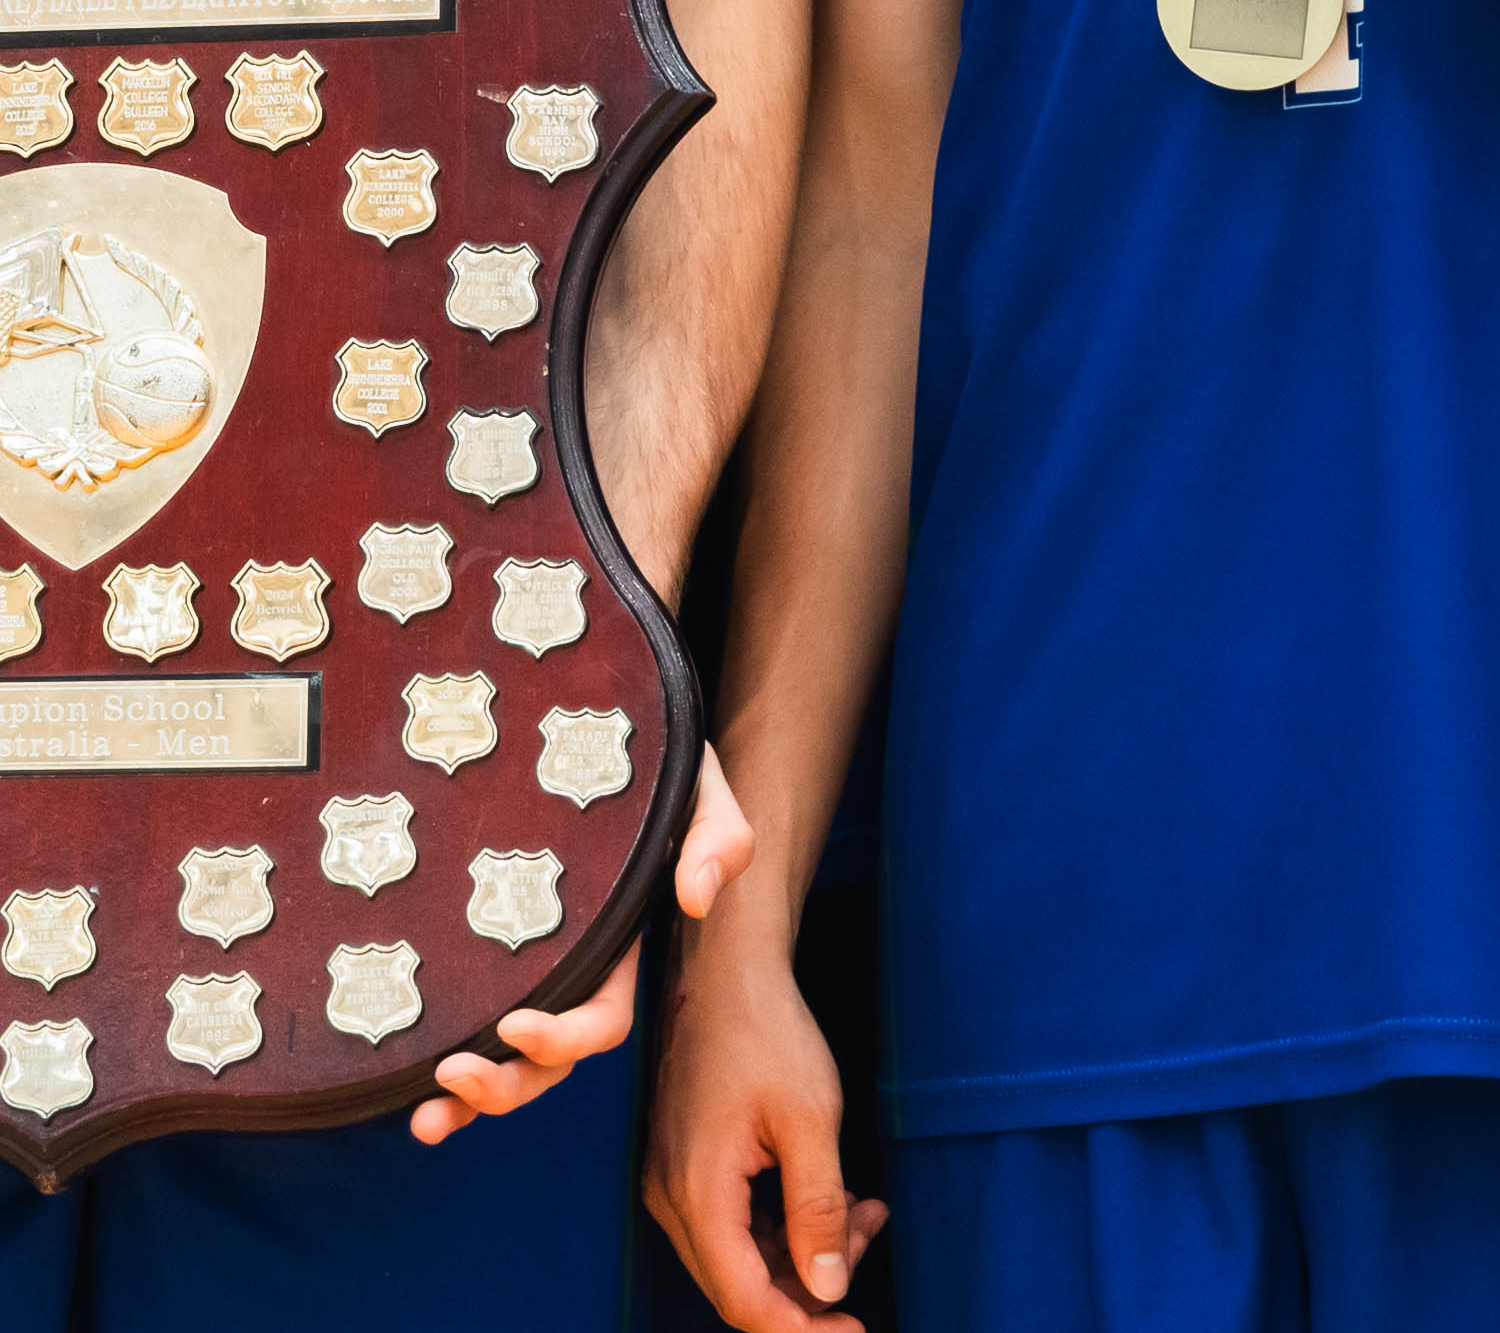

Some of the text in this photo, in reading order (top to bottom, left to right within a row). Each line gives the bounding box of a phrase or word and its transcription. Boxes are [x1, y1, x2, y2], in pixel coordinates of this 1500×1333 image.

[122, 76, 170, 89] MARCELLIN
[257, 83, 291, 93] SENIOR
[125, 92, 168, 104] COLLEGE
[4, 110, 47, 122] COLLEGE
[124, 106, 168, 118] BULLEEN
[254, 107, 294, 118] COLLEGE
[529, 136, 577, 147] SCHOOL
[379, 169, 406, 180] LAKE
[377, 207, 405, 218] 2000
[357, 388, 400, 400] COLLEGE
[256, 603, 304, 615] Berwick
[103, 693, 226, 723] School
[156, 729, 232, 757] Men
